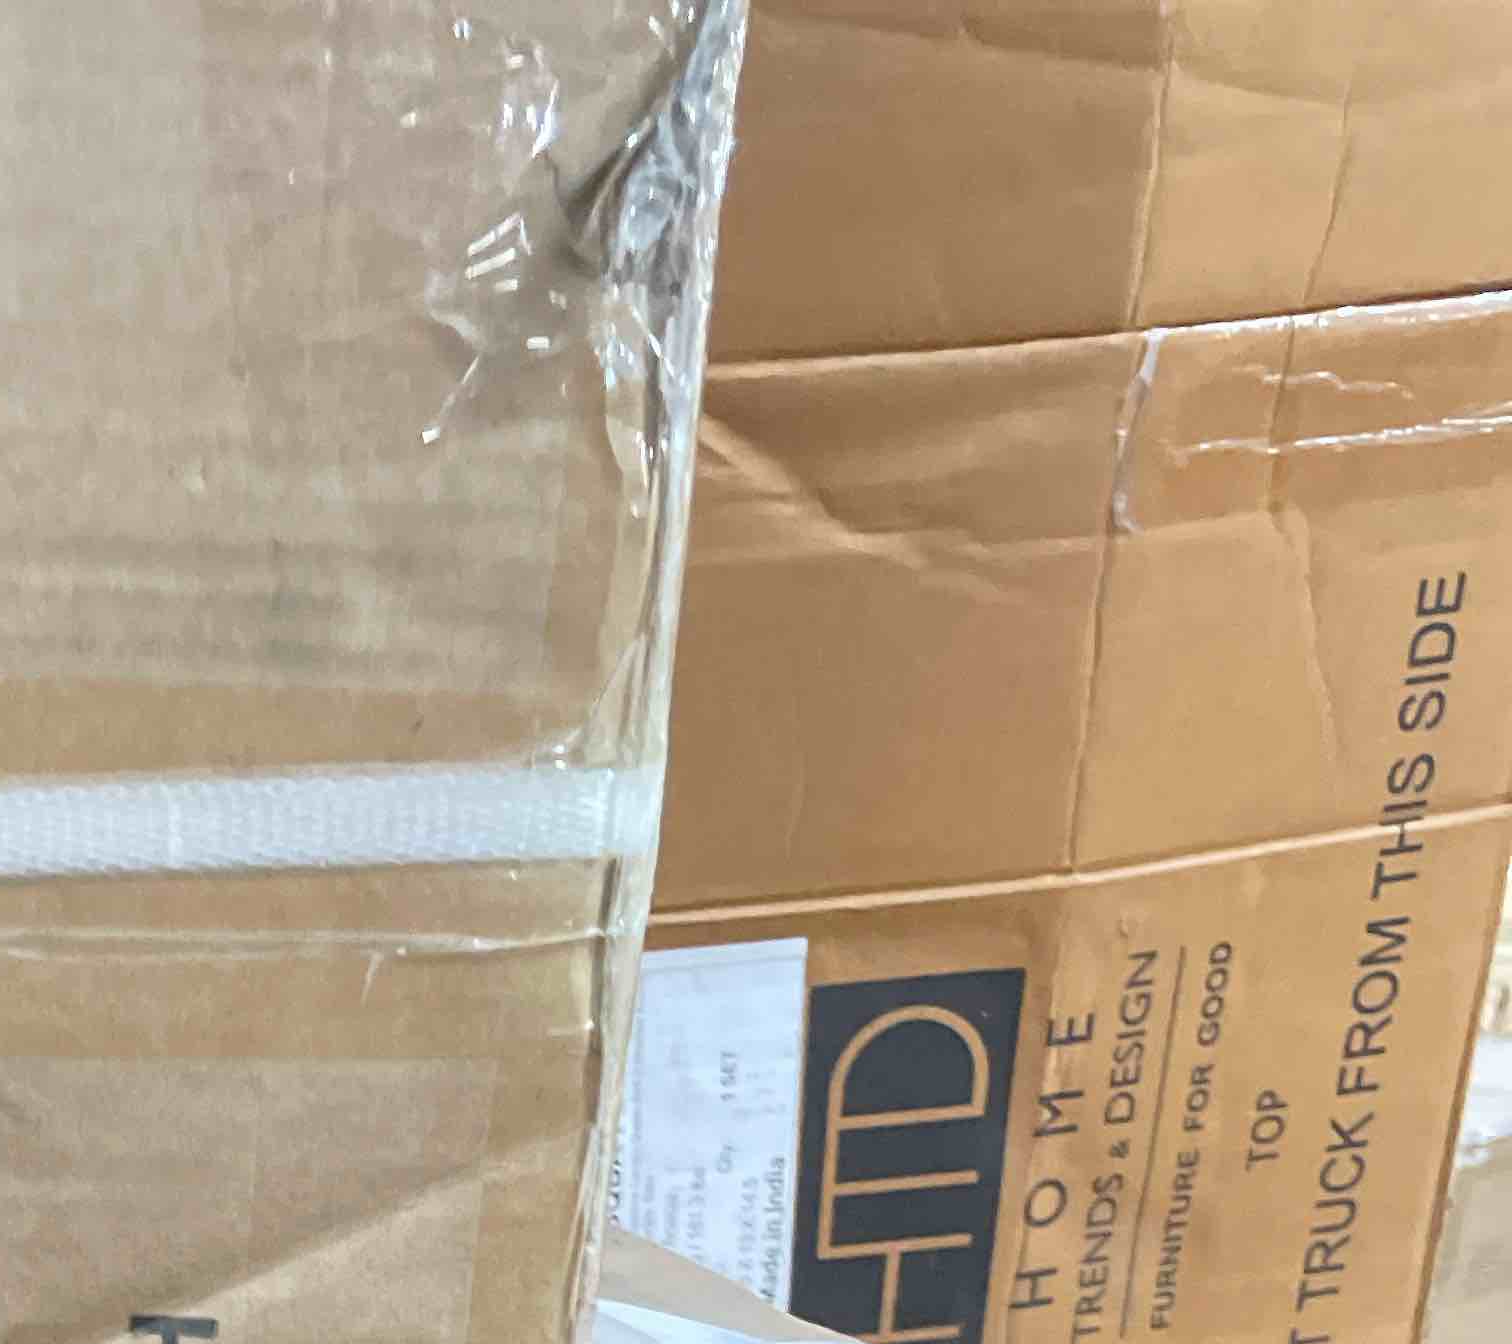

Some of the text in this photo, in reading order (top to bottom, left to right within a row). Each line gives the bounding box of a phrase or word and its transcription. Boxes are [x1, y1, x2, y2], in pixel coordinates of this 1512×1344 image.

[1397, 571, 1468, 732] SIDE
[1371, 752, 1436, 902] THIS
[1104, 949, 1160, 1126] DESIGN
[1335, 914, 1411, 1098] FROM
[1009, 1012, 1096, 1310] HOME
[1109, 1138, 1131, 1161] &
[1149, 940, 1234, 1332] FURNITURE FOR GOOD
[1245, 1088, 1289, 1172] TOP
[1296, 1111, 1375, 1313] TRUCK
